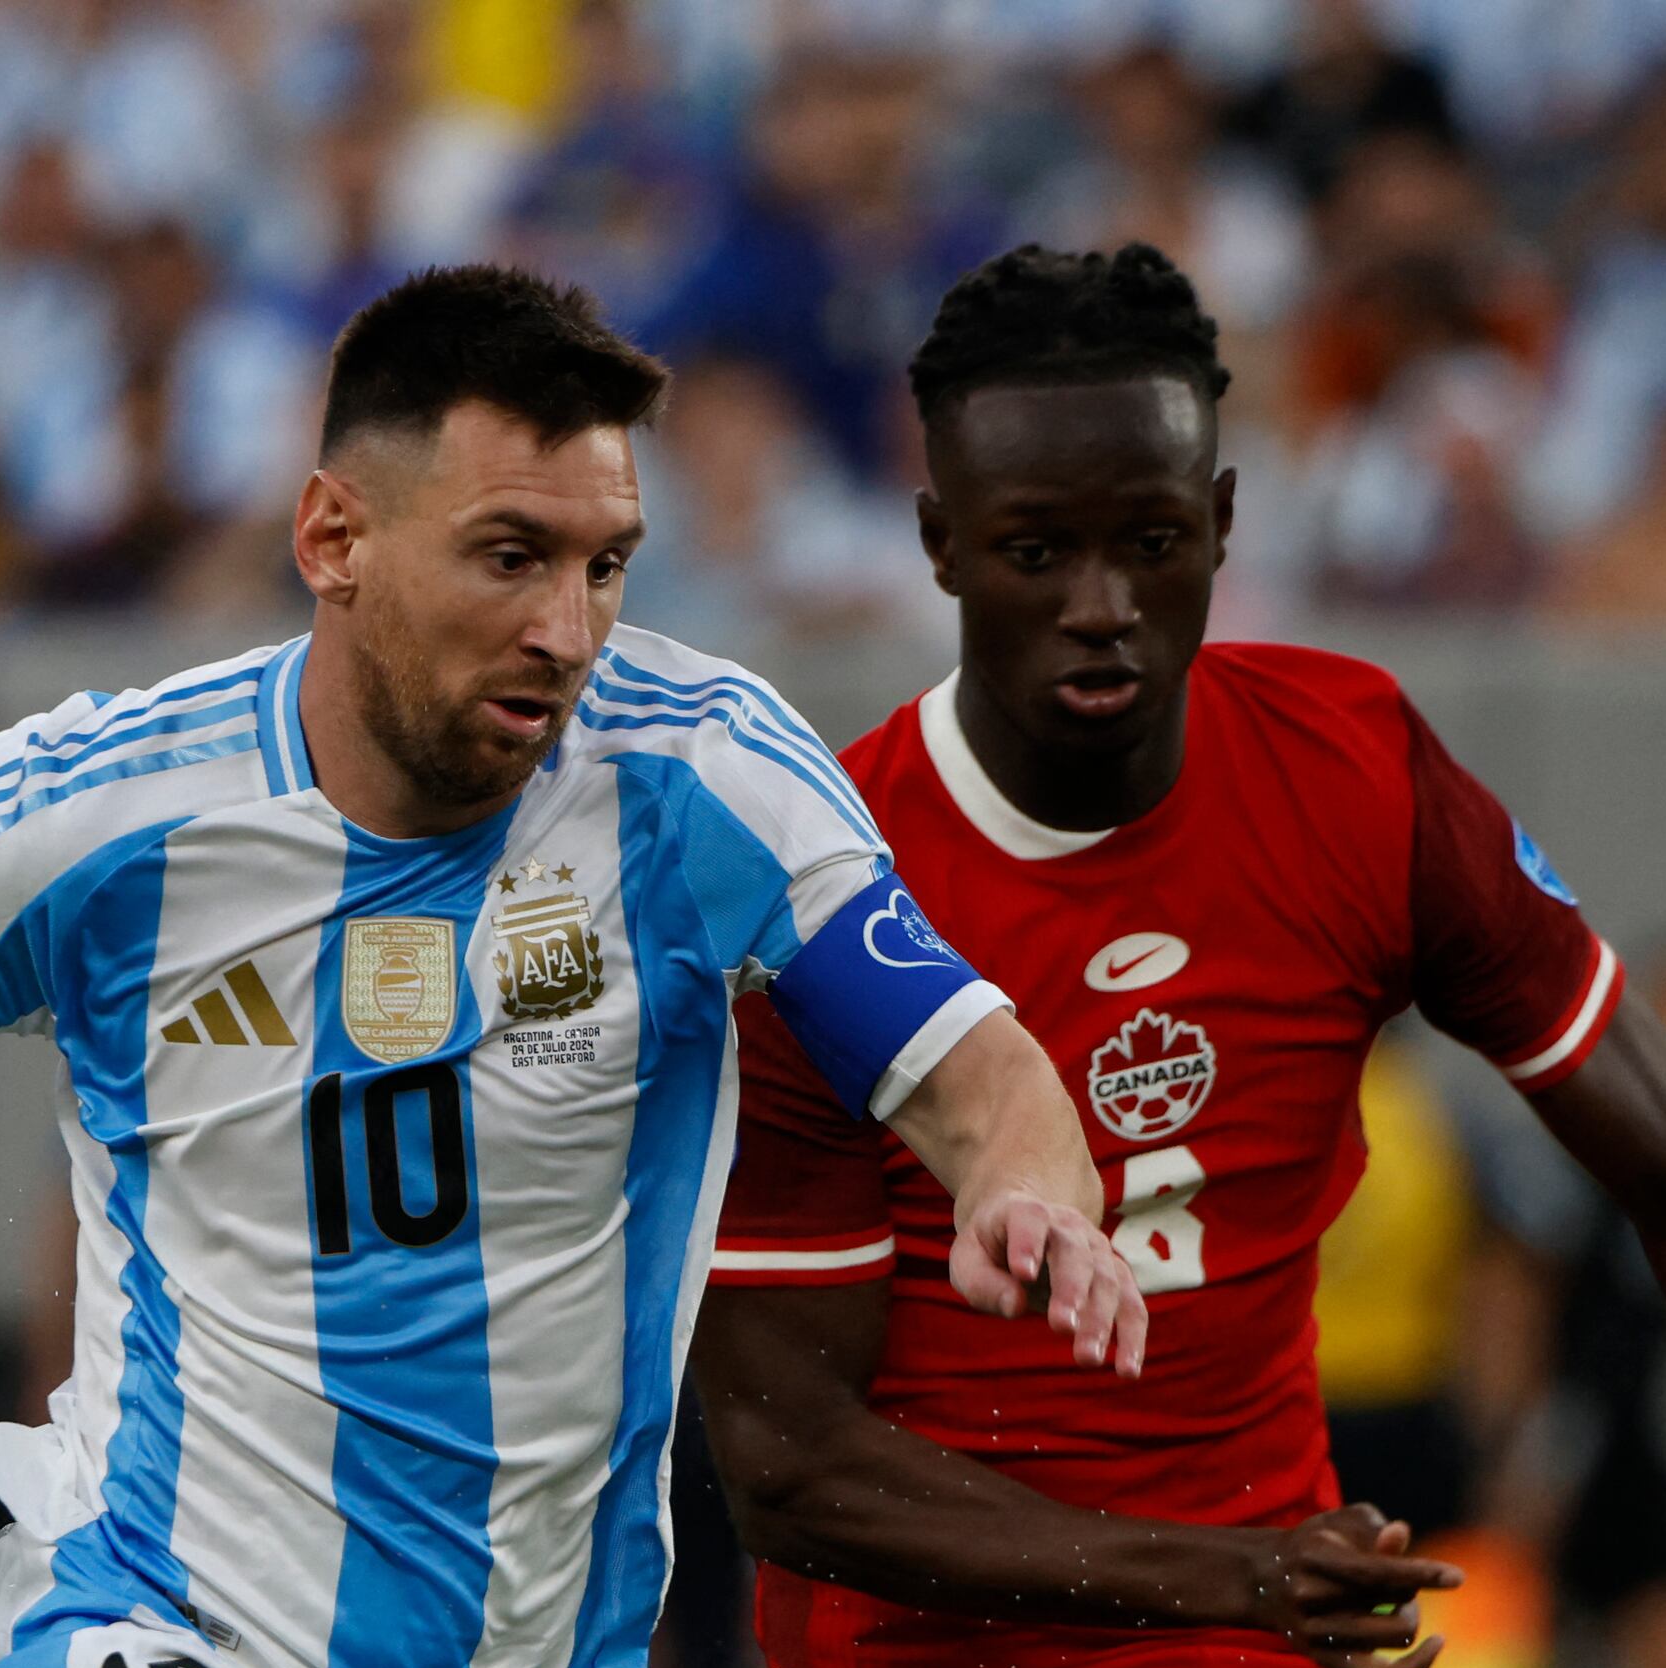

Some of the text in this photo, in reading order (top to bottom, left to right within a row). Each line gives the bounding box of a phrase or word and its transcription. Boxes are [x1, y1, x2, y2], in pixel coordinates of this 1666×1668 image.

[521, 929, 582, 988] AFA
[503, 1030, 553, 1044] ARGENTINA
[511, 1040, 594, 1055] 09 DE JULIO 2024
[511, 1051, 596, 1068] EAST RUTHERFORD
[1094, 1057, 1209, 1099] CANADA
[309, 1064, 469, 1255] 10
[1110, 1144, 1207, 1294] 8
